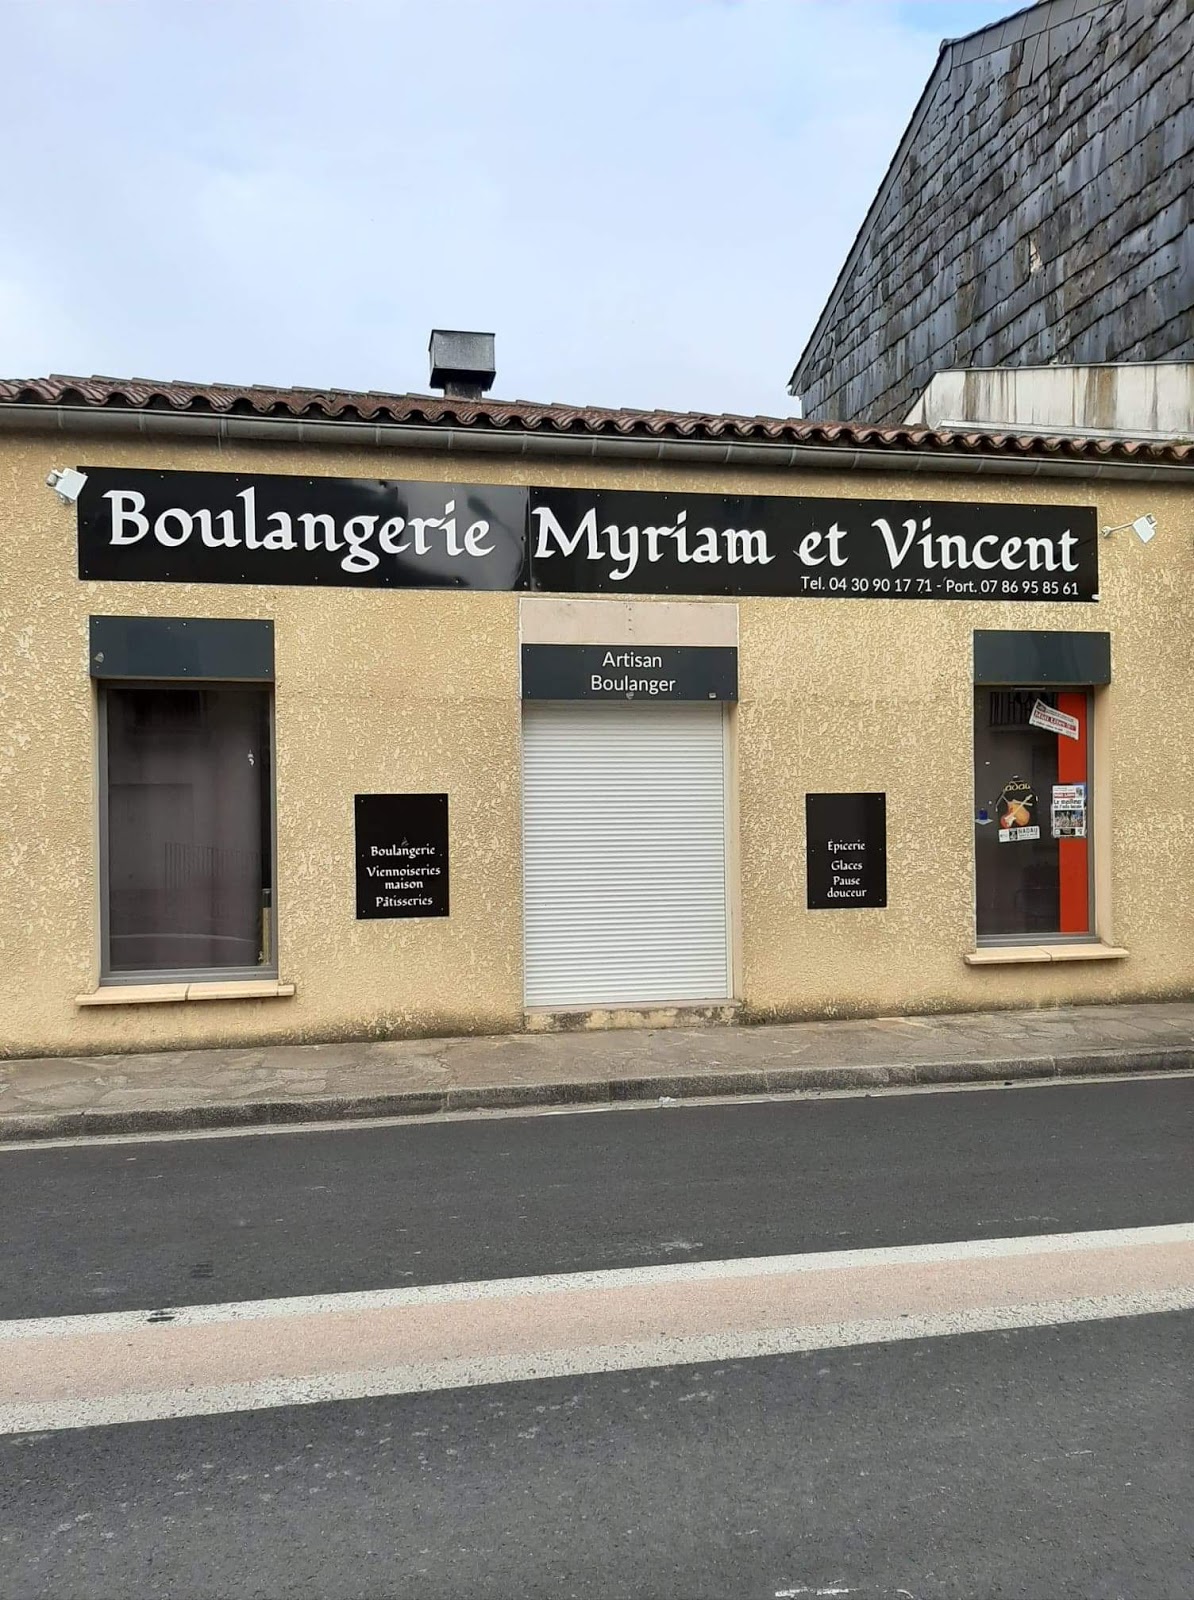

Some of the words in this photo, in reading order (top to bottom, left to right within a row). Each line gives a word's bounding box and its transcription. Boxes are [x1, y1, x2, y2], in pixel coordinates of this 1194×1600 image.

[102, 487, 495, 573] Boulangerie
[532, 504, 773, 581] Myriam
[798, 522, 849, 568] et
[871, 517, 1079, 573] Vincent
[800, 575, 826, 591] Tel.
[828, 576, 848, 591] 04
[851, 577, 869, 592] 30
[872, 577, 891, 592] 90
[894, 578, 912, 592] 17
[916, 578, 932, 593] 71
[946, 579, 978, 593] Port.
[980, 579, 998, 594] 07
[1001, 580, 1019, 594] 86
[1021, 580, 1039, 594] 95
[1042, 581, 1059, 595] 85
[1062, 582, 1079, 595] 61
[602, 651, 662, 668] Artisan
[591, 674, 676, 695] Boulanger
[370, 843, 435, 859] Boulangerie
[366, 863, 441, 877] Viennoiseries
[831, 859, 863, 871] Glaces
[384, 877, 423, 889] maison
[833, 875, 861, 886] Pause
[827, 886, 868, 898] douceur
[375, 893, 433, 907] Pâtisseries
